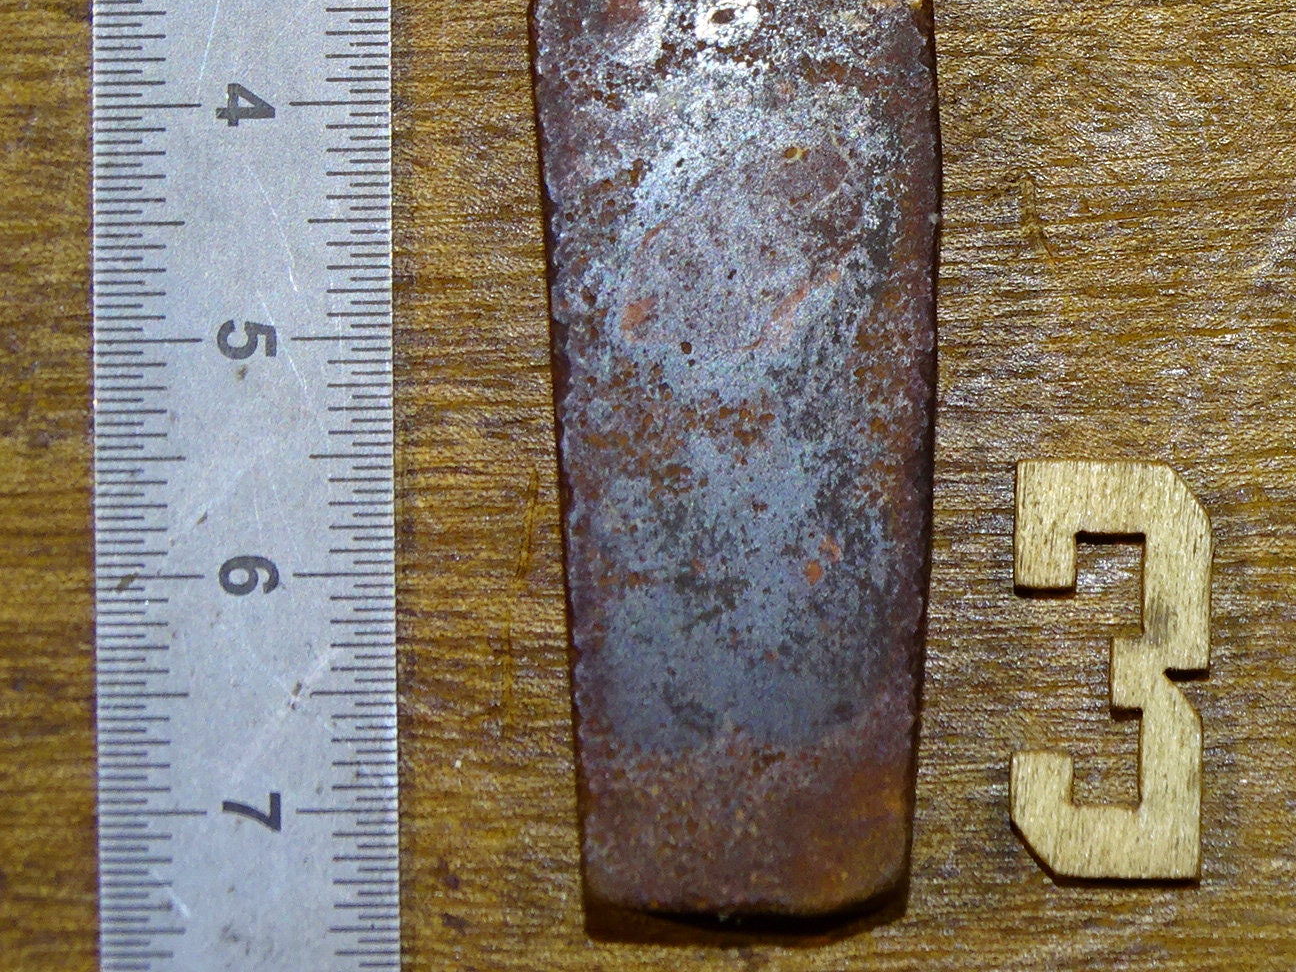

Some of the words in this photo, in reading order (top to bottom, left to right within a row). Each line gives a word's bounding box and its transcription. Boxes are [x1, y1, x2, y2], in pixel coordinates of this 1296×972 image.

[215, 83, 276, 126] 4
[216, 319, 277, 360] 5
[218, 555, 280, 596] 6
[1009, 460, 1214, 884] 3
[221, 792, 281, 832] 7
